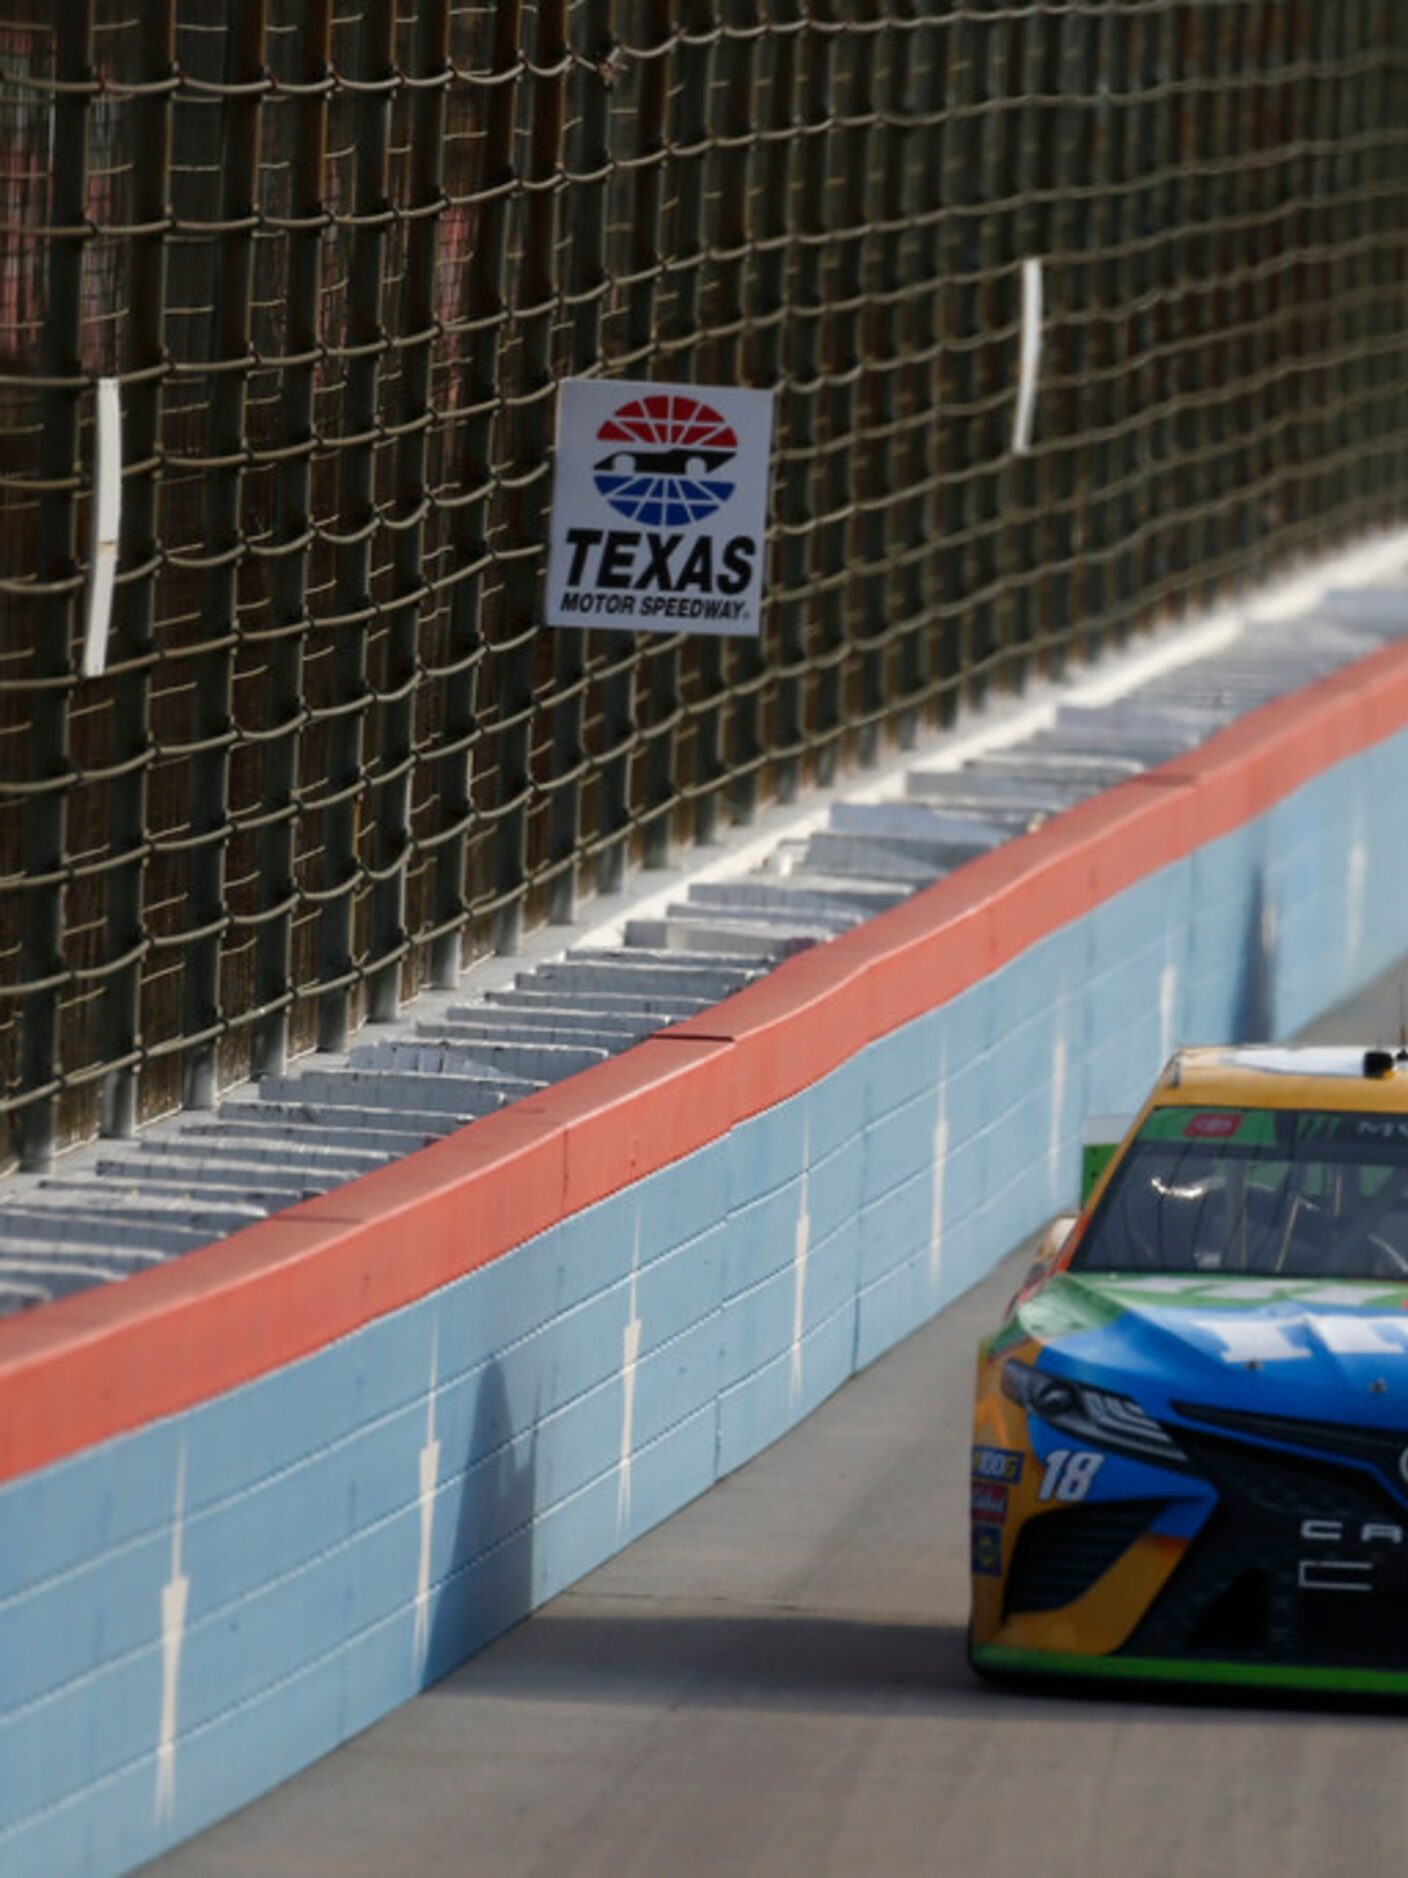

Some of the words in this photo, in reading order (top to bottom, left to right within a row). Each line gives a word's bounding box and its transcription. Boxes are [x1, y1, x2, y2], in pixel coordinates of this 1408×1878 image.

[565, 528, 757, 596] TEXAS
[559, 592, 636, 614] MOTOR
[639, 596, 747, 620] SPEEDWAY
[1038, 1449, 1105, 1501] 18
